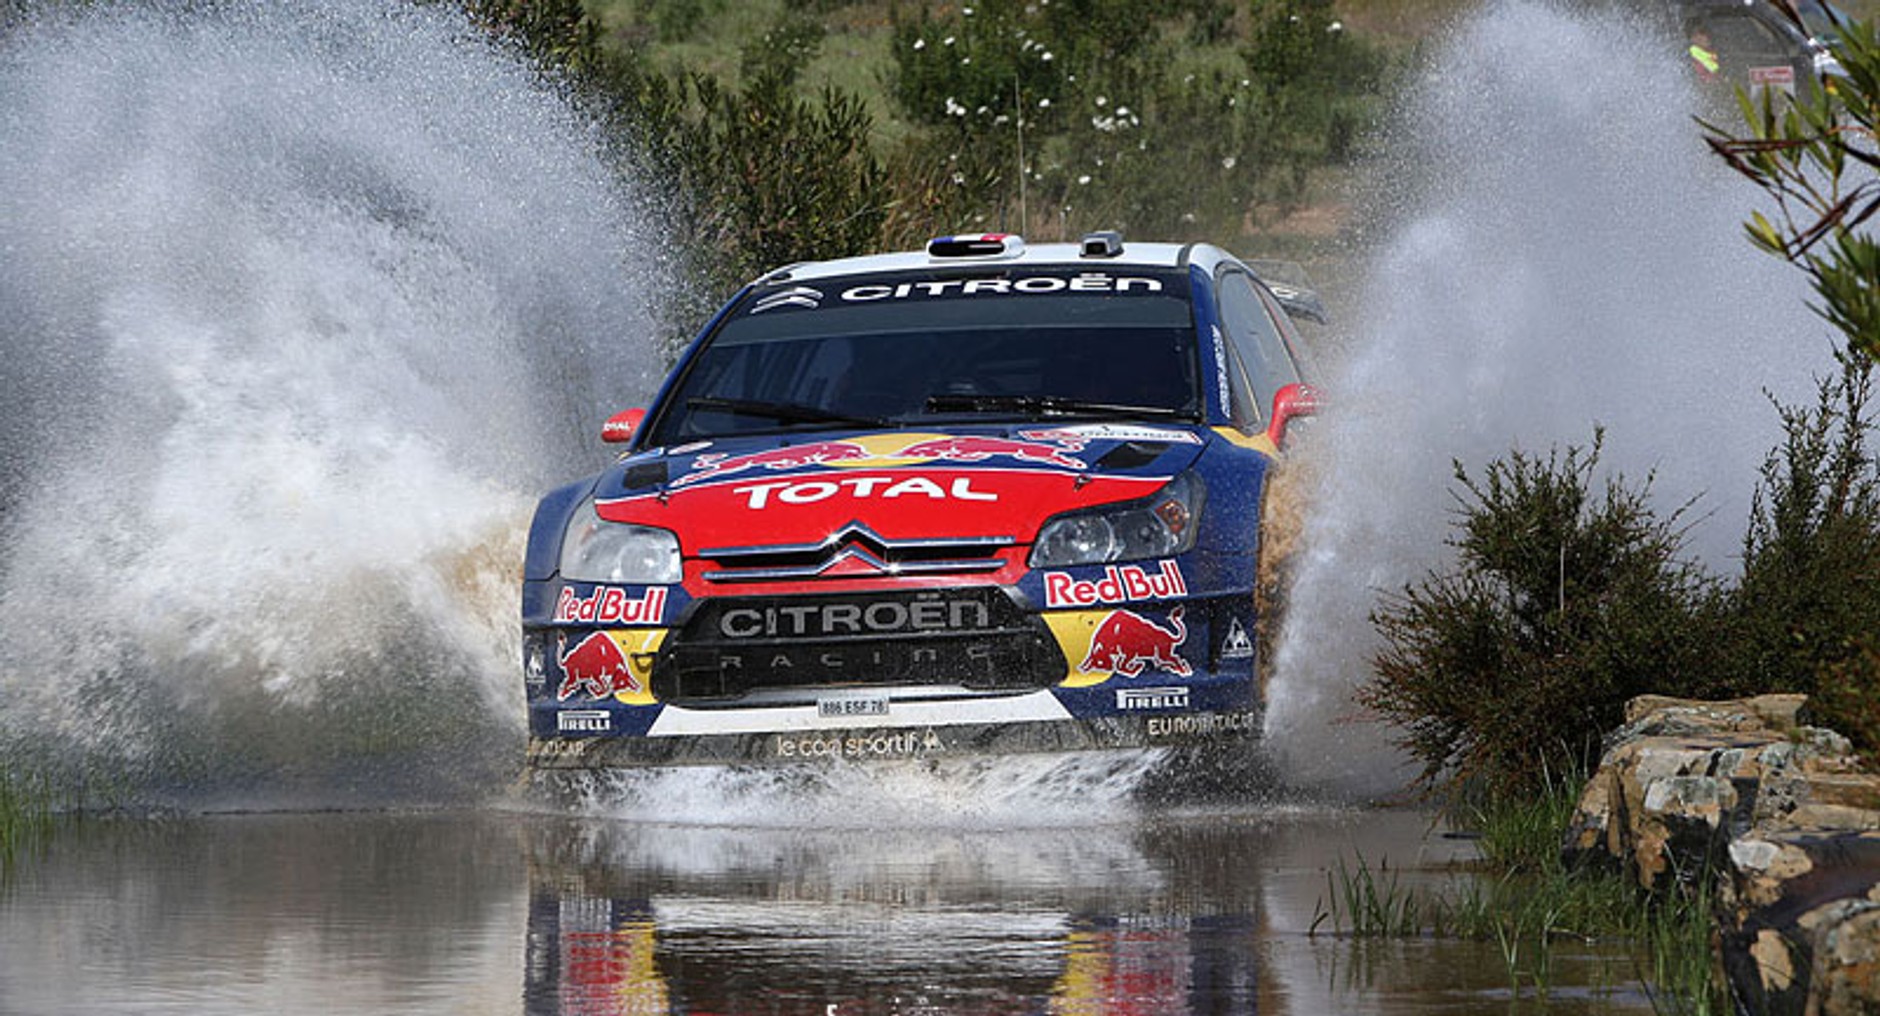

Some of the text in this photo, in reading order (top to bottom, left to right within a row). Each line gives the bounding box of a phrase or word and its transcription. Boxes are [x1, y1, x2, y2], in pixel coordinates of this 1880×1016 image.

[603, 421, 631, 431] OTAL
[733, 477, 998, 510] TOTAL
[1044, 559, 1188, 607] Red Bull
[554, 586, 668, 624] Red Bull
[1116, 686, 1189, 709] PIRELLI
[557, 710, 610, 731] PIRELLI
[777, 736, 796, 757] le
[845, 731, 918, 758] sportif
